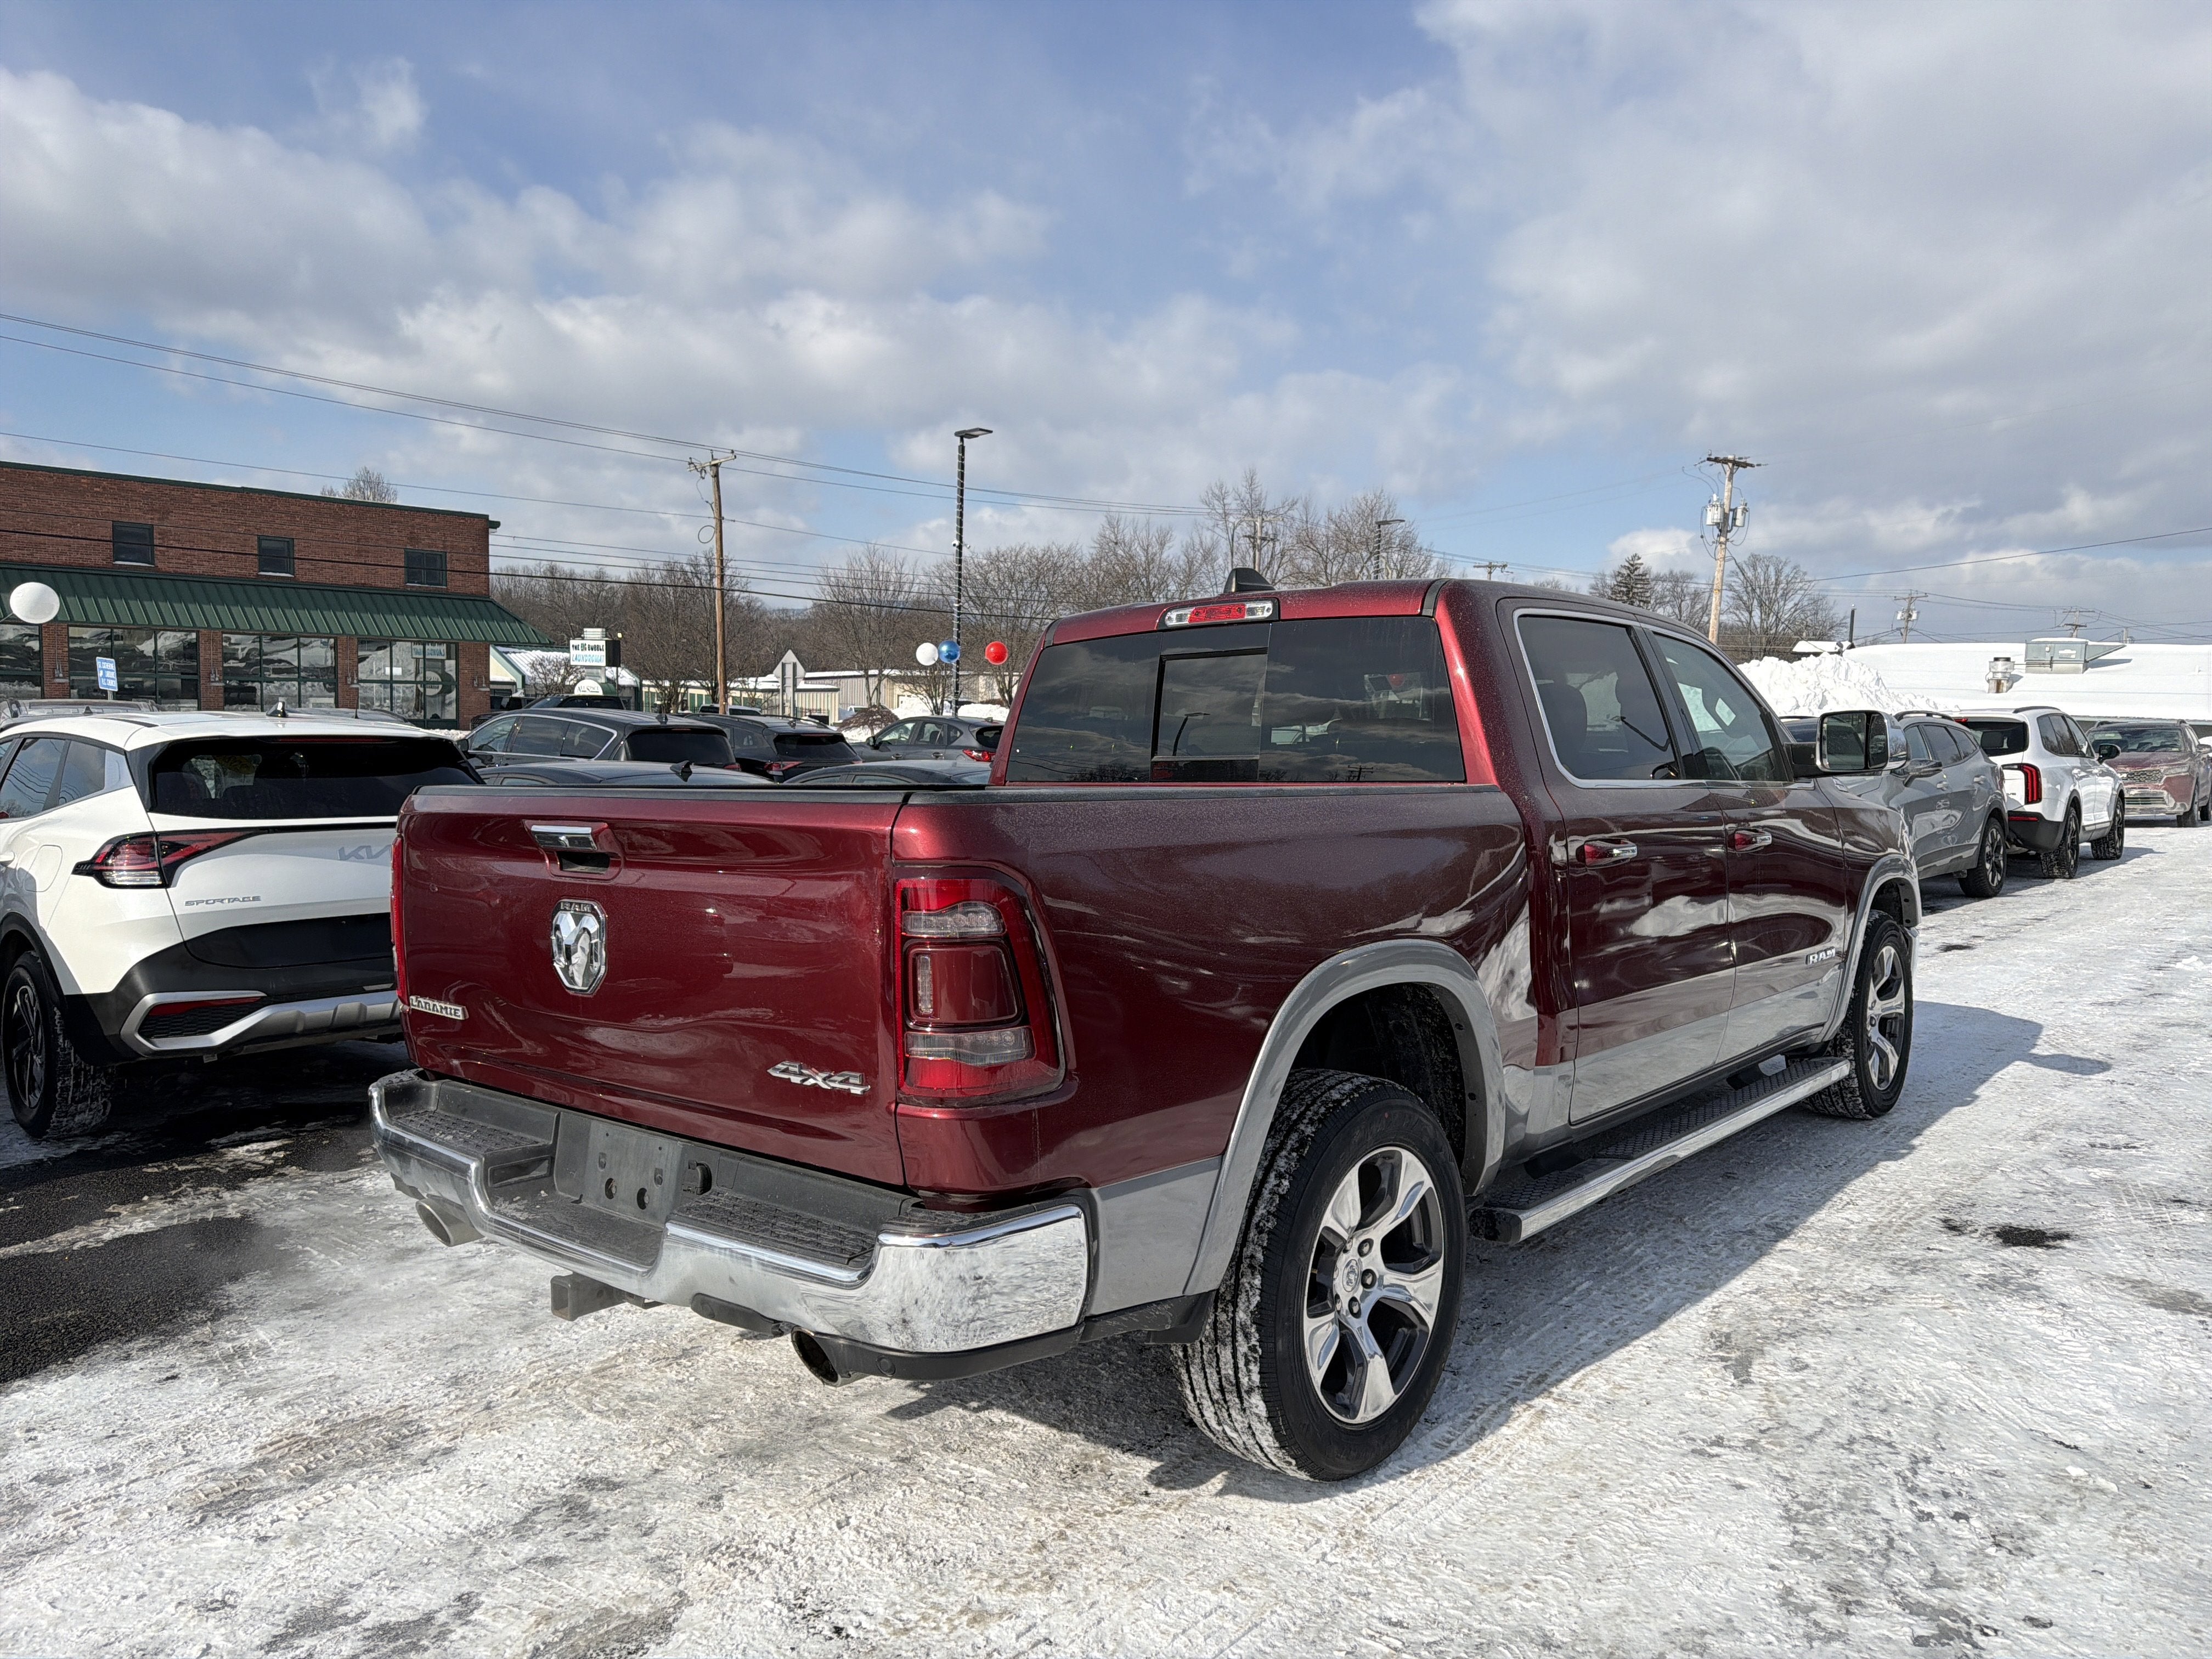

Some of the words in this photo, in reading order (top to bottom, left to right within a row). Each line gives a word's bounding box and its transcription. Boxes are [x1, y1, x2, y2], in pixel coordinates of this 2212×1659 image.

[572, 653, 605, 663] LAUNDROMAT
[185, 896, 261, 906] SPORTAGE
[560, 902, 592, 912] RAM
[1805, 946, 1835, 966] RAM
[410, 998, 461, 1018] LARAMIE
